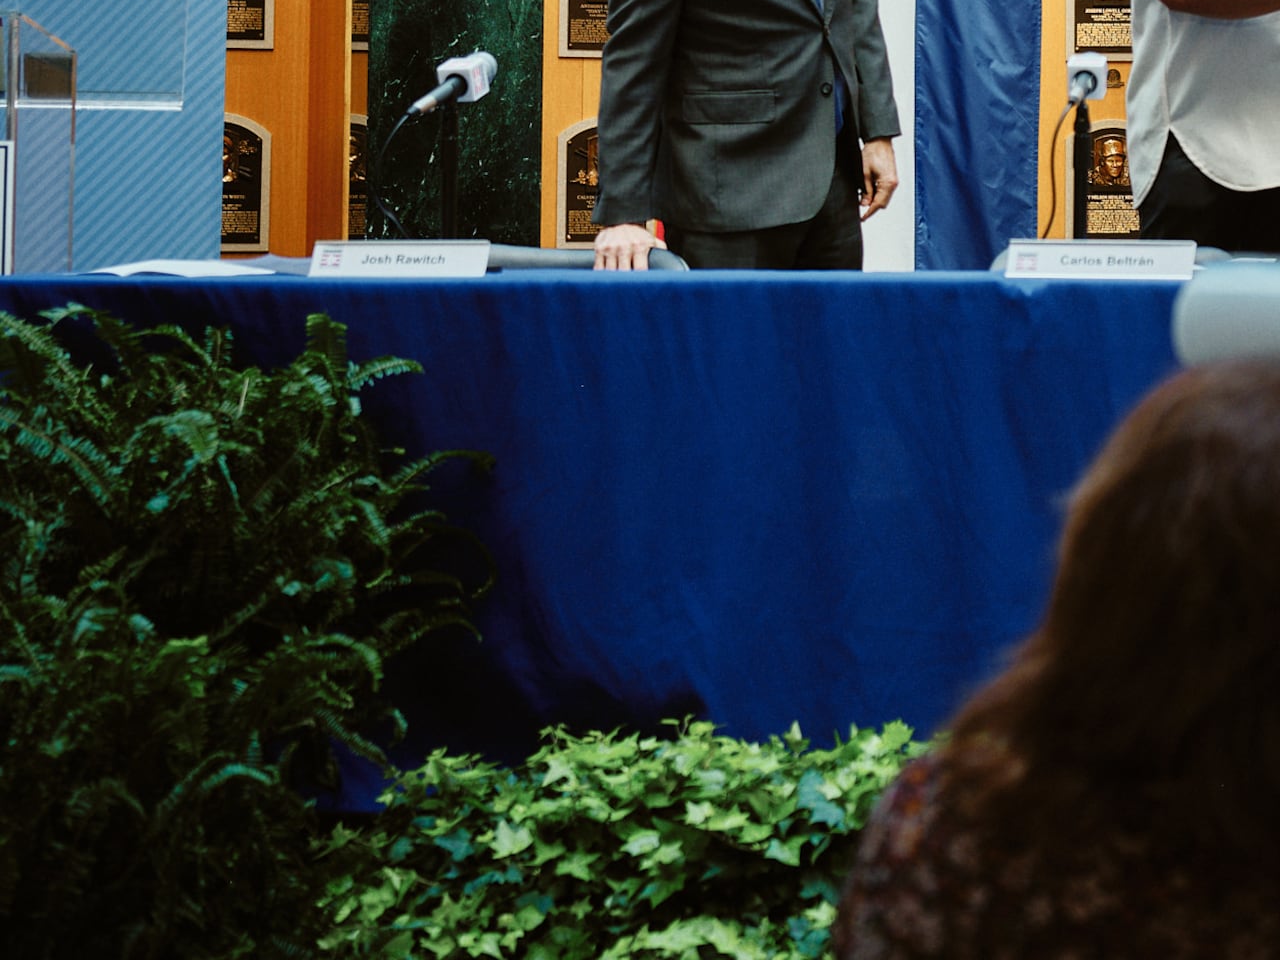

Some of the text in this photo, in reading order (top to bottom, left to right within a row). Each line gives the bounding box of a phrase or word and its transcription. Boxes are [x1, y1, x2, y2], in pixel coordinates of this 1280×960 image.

[361, 254, 445, 265] Josh Rawitch
[1060, 255, 1102, 266] Carlos
